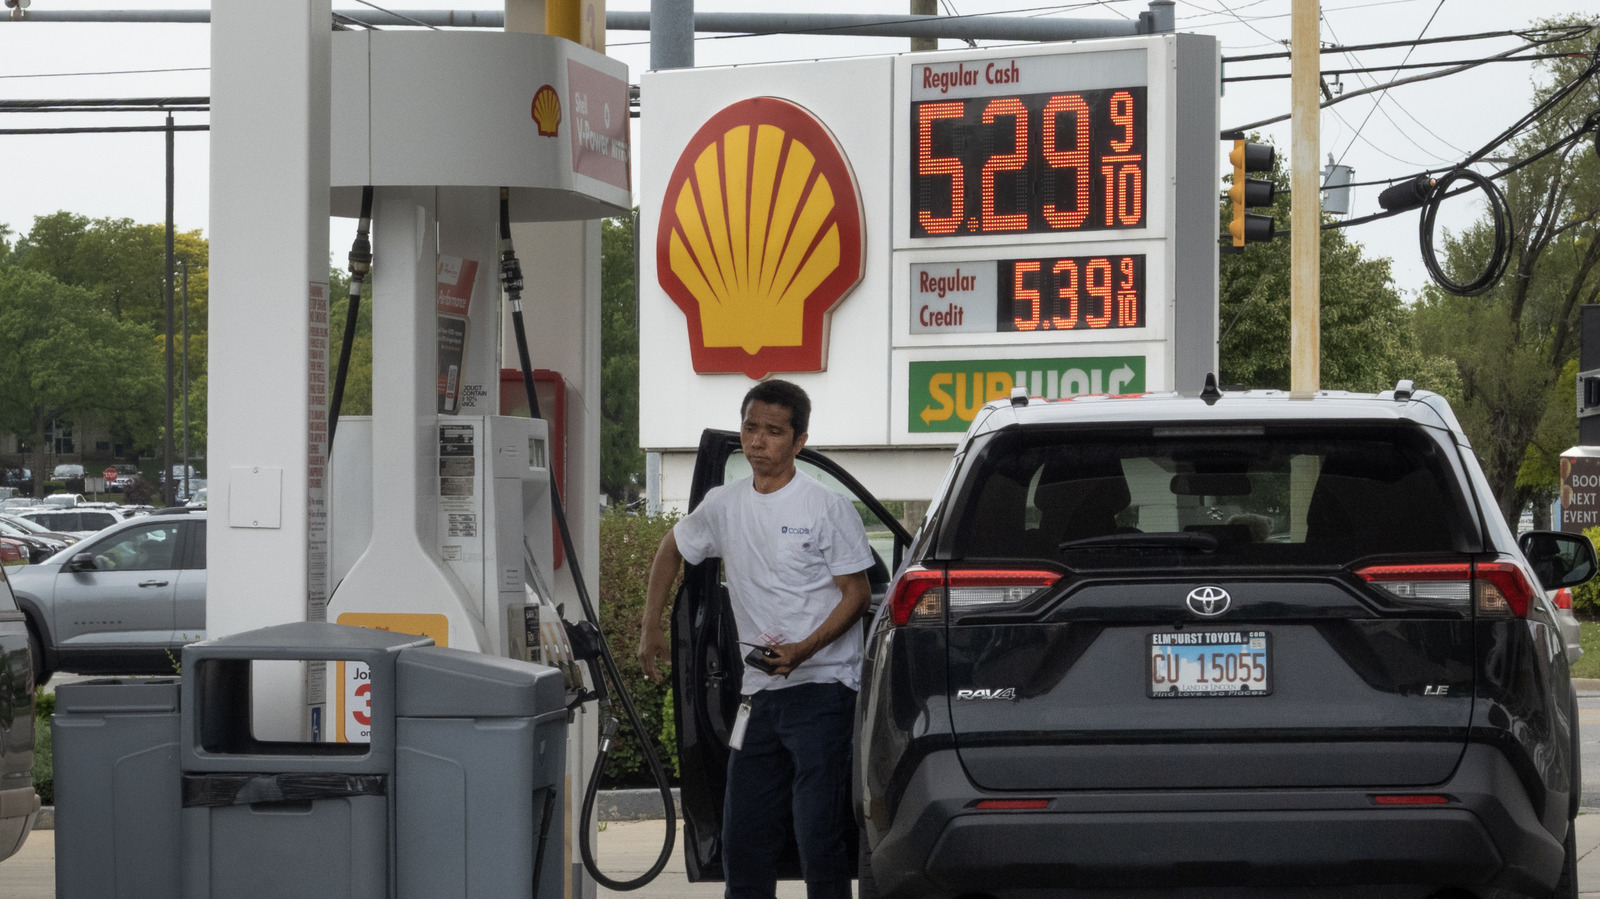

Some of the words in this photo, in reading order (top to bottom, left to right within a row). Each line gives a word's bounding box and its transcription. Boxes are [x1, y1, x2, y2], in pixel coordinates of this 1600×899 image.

[923, 63, 979, 93] Regular
[985, 60, 1020, 84] Cash
[575, 91, 588, 115] Shell
[576, 117, 609, 156] V-Power
[919, 94, 1090, 234] 5.29
[1110, 91, 1134, 153] 9
[1101, 164, 1142, 226] 10
[919, 268, 977, 299] Regular
[1014, 258, 1112, 331] 5.39
[1120, 257, 1134, 290] 9
[919, 303, 964, 328] Credit
[1117, 294, 1137, 327] 10
[1573, 475, 1600, 488] BOO
[1569, 493, 1597, 505] NEXT
[1563, 511, 1598, 523] EVENT
[1152, 633, 1203, 645] ELMHURST
[1205, 632, 1242, 644] TOYOTA
[1152, 653, 1180, 684] CU
[1196, 652, 1266, 684] 15055
[957, 687, 1016, 701] RAV4
[1210, 683, 1237, 691] LINCOLN
[1210, 689, 1225, 697] Go
[1424, 685, 1450, 696] LE
